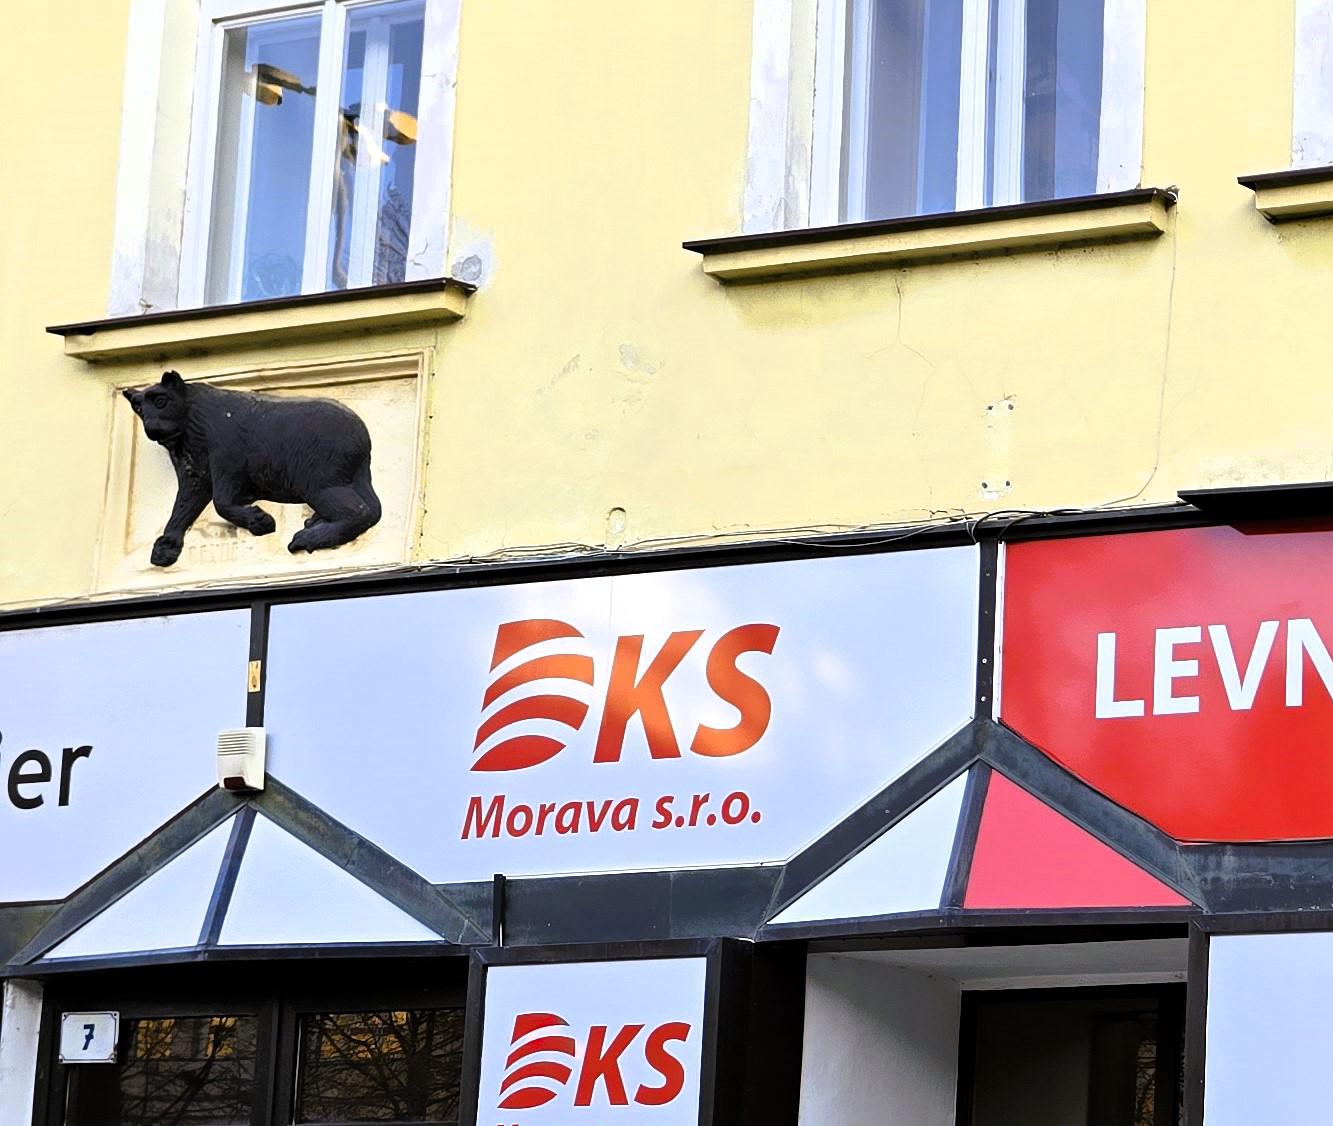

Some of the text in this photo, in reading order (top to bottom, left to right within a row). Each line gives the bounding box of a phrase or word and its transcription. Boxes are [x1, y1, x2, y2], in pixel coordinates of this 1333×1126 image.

[0, 731, 93, 810] er
[461, 790, 762, 841] Morava s.r.o.
[83, 1023, 96, 1051] 7
